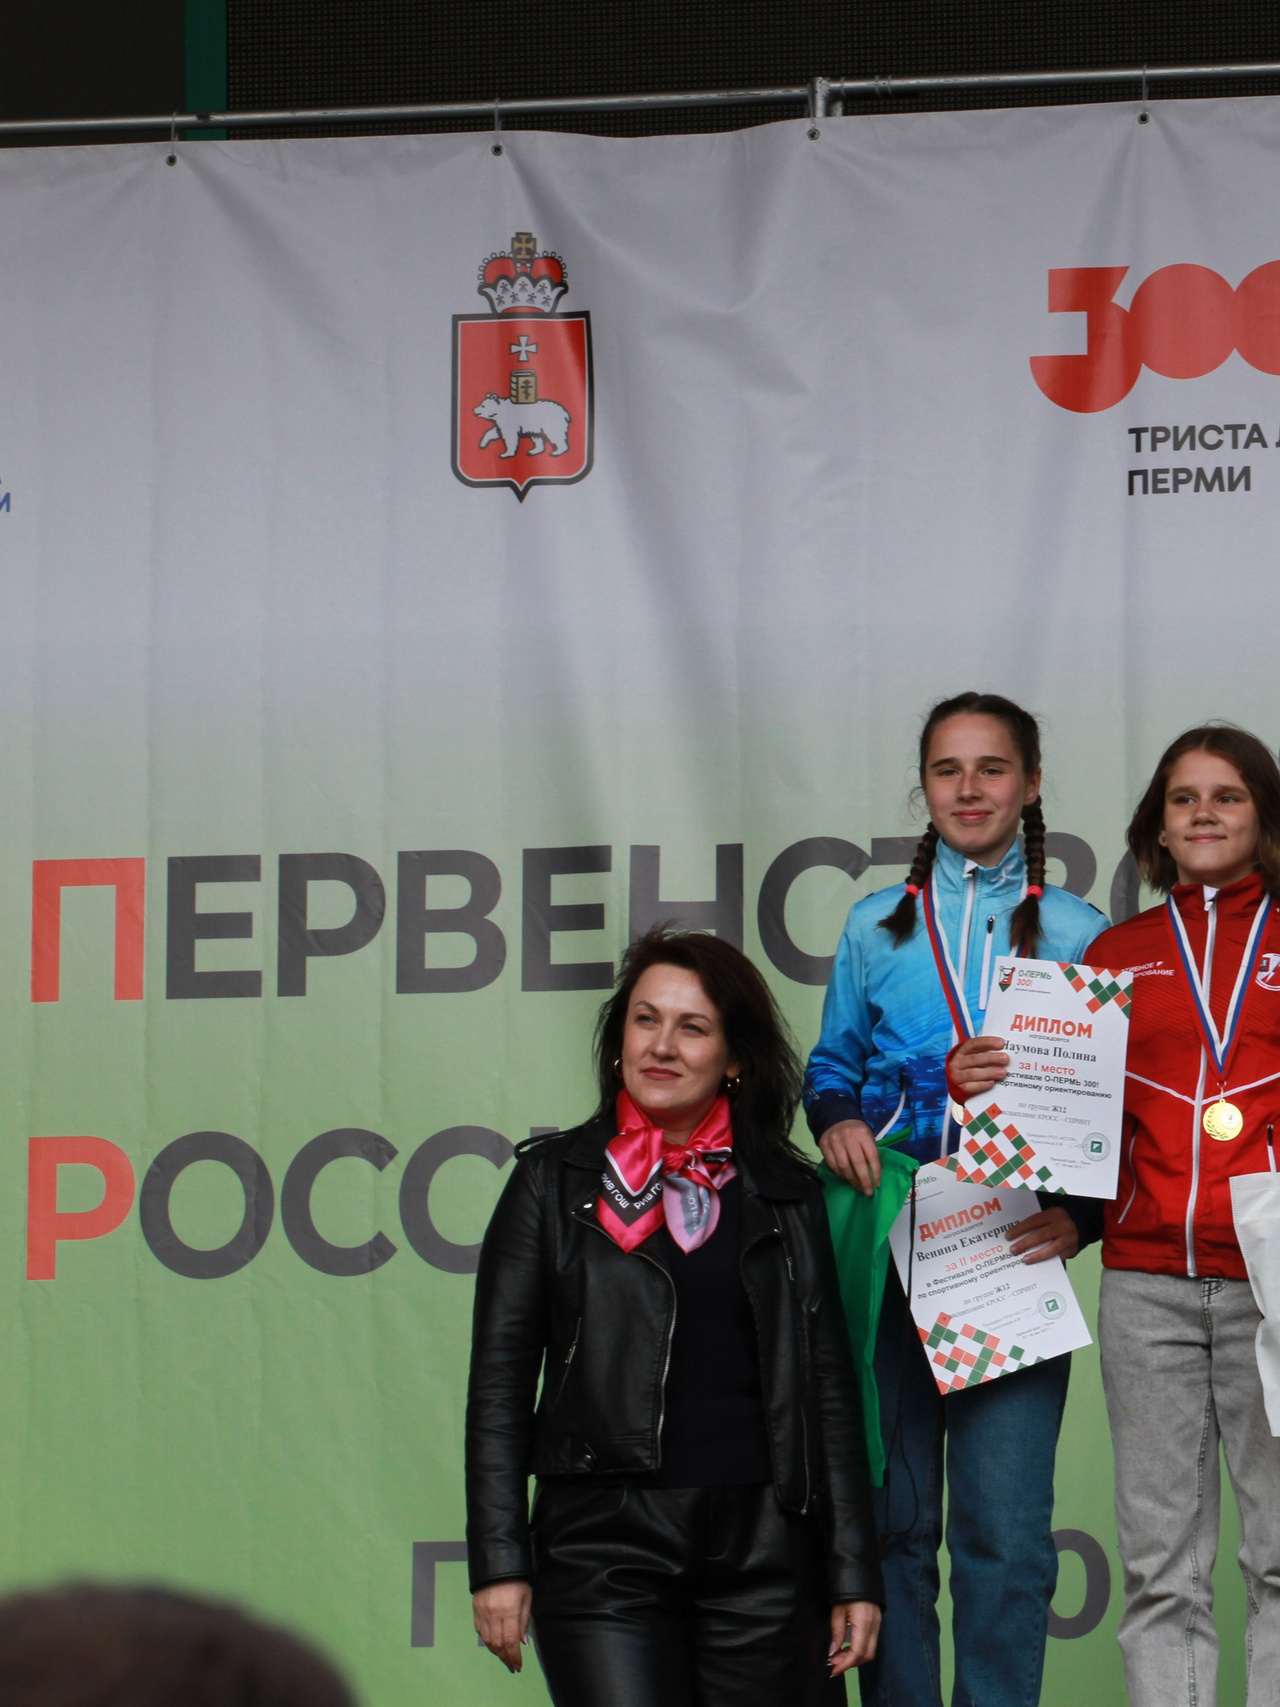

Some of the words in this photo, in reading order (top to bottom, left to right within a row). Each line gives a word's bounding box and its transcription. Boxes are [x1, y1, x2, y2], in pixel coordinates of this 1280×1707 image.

[1128, 424, 1268, 453] ТРИСТА
[1128, 466, 1252, 496] ПЕРМИ
[31, 832, 1148, 1003] ПЕРВЕНС
[1018, 969, 1052, 980] О-ПЕРМЬ
[1010, 1014, 1093, 1039] ДИПЛОМ
[1053, 1046, 1097, 1062] Полина
[1005, 1071, 1042, 1082] естивале
[1044, 1074, 1081, 1086] О-ПЕРМЬ
[1019, 1062, 1031, 1070] за
[1041, 1064, 1076, 1076] место
[1045, 1084, 1112, 1099] ориентированию
[1052, 1104, 1067, 1114] Ж12
[26, 1126, 560, 1281] РОСС
[611, 1189, 630, 1209] ГОШ
[633, 1192, 654, 1209] РИВ
[650, 1182, 662, 1195] ГО
[918, 1197, 1002, 1242] ДИПЛОМ
[916, 1243, 958, 1262] Венина
[944, 1263, 958, 1272] за
[970, 1244, 1004, 1263] место
[933, 1267, 975, 1285] Фестивале
[917, 1292, 927, 1300] по
[928, 1275, 978, 1297] спортивному
[995, 1283, 1011, 1294] Ж12
